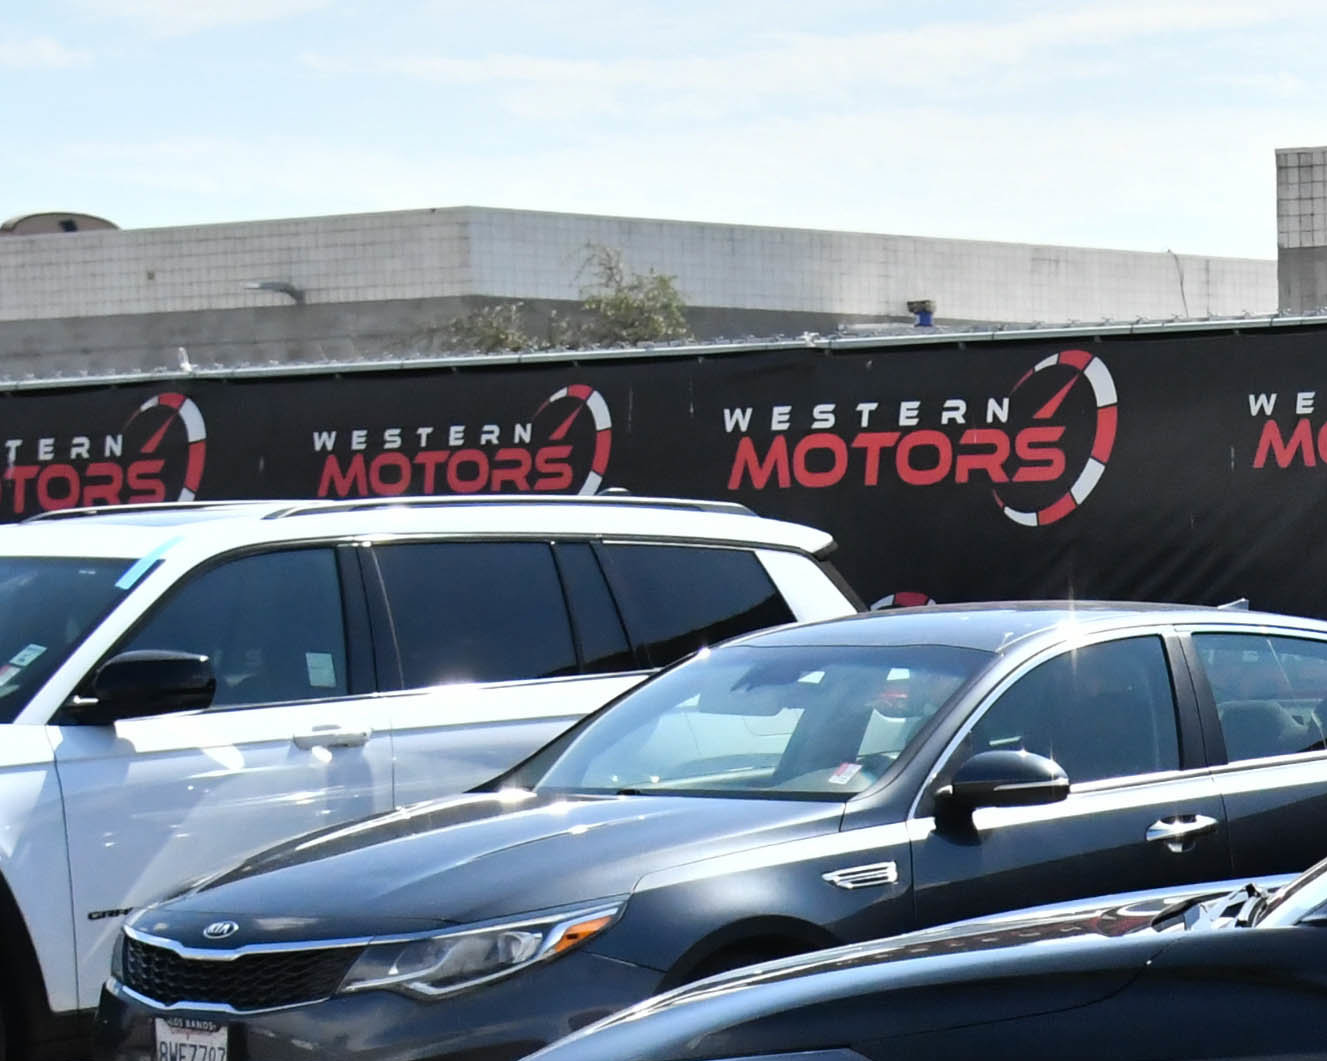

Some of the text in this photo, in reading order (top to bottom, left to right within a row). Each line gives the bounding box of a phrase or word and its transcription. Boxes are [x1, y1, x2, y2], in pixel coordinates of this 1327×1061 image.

[313, 422, 532, 452] WESTERN
[723, 397, 1010, 433] WESTERN
[318, 444, 574, 497] MOTORS
[727, 425, 1067, 491] MOTORS
